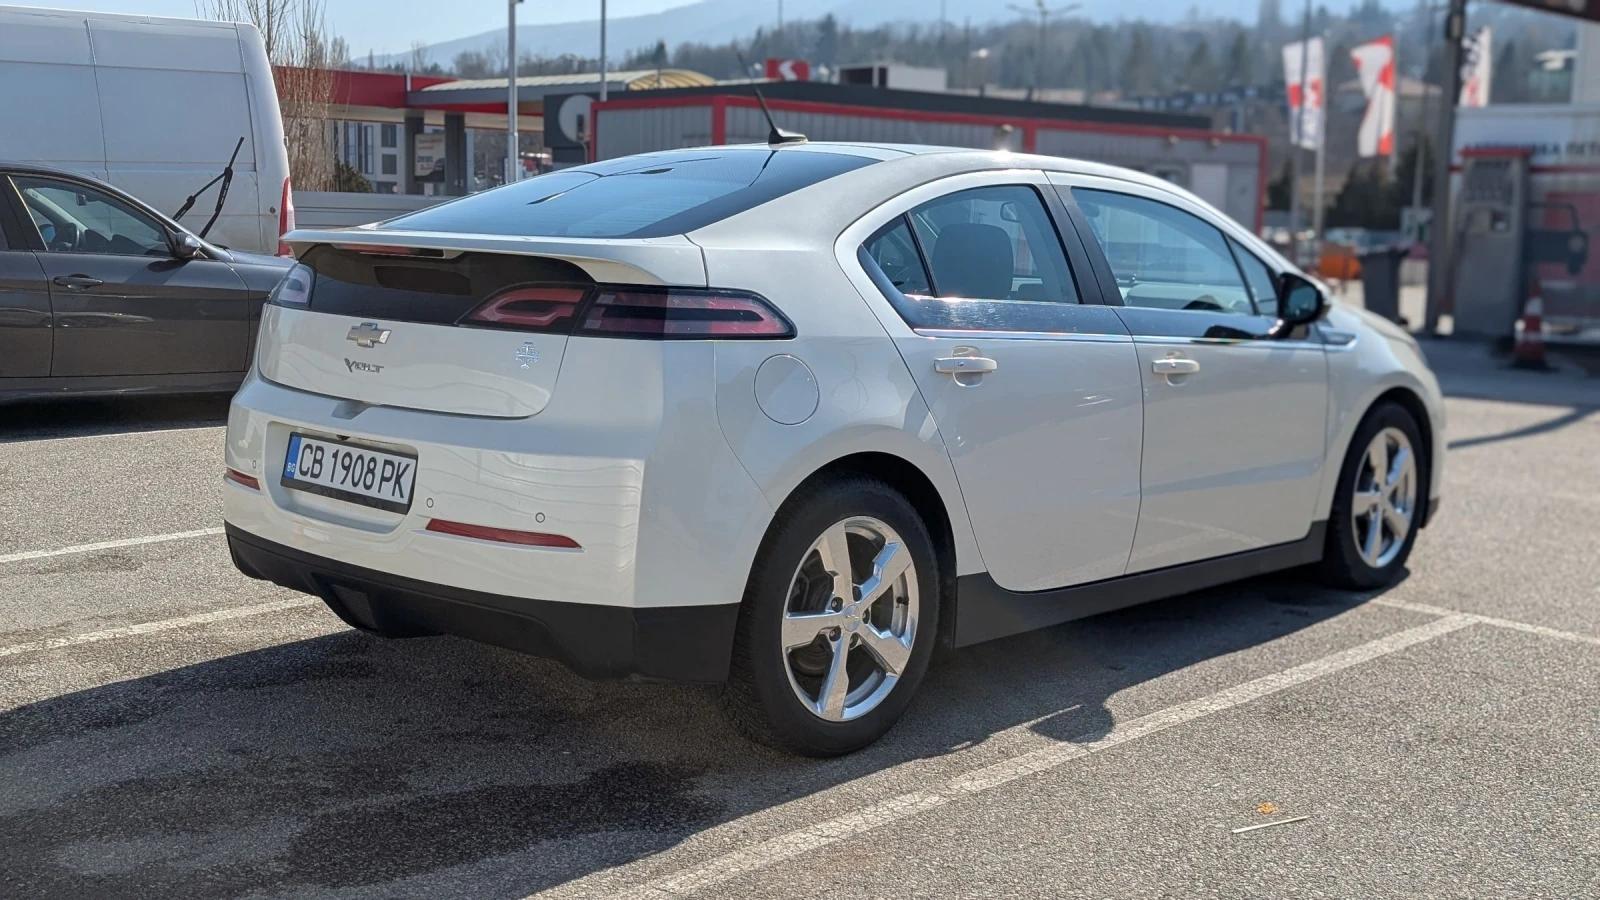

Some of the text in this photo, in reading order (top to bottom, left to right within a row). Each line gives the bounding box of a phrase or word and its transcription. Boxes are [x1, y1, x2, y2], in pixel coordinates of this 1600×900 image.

[287, 462, 296, 473] BG
[299, 443, 411, 499] CB 1908 PK
